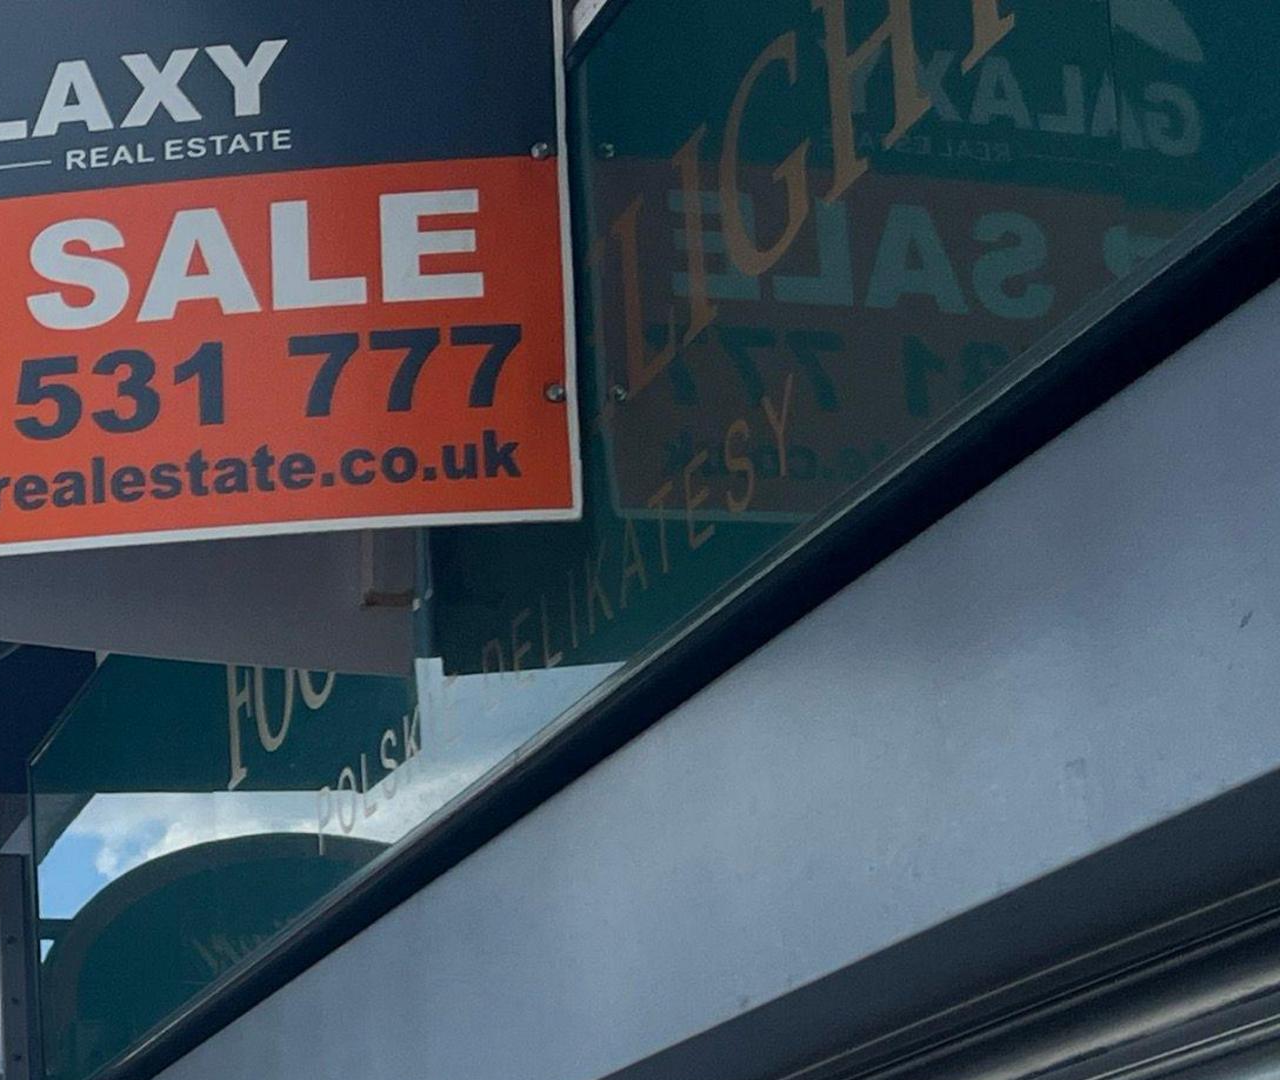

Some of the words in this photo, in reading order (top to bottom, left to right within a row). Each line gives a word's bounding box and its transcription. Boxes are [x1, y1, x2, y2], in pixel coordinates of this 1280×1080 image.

[63, 141, 155, 171] REAL
[162, 127, 293, 161] ESTATE
[24, 187, 486, 331] SALE
[13, 339, 229, 441] 531
[288, 323, 523, 418] 777
